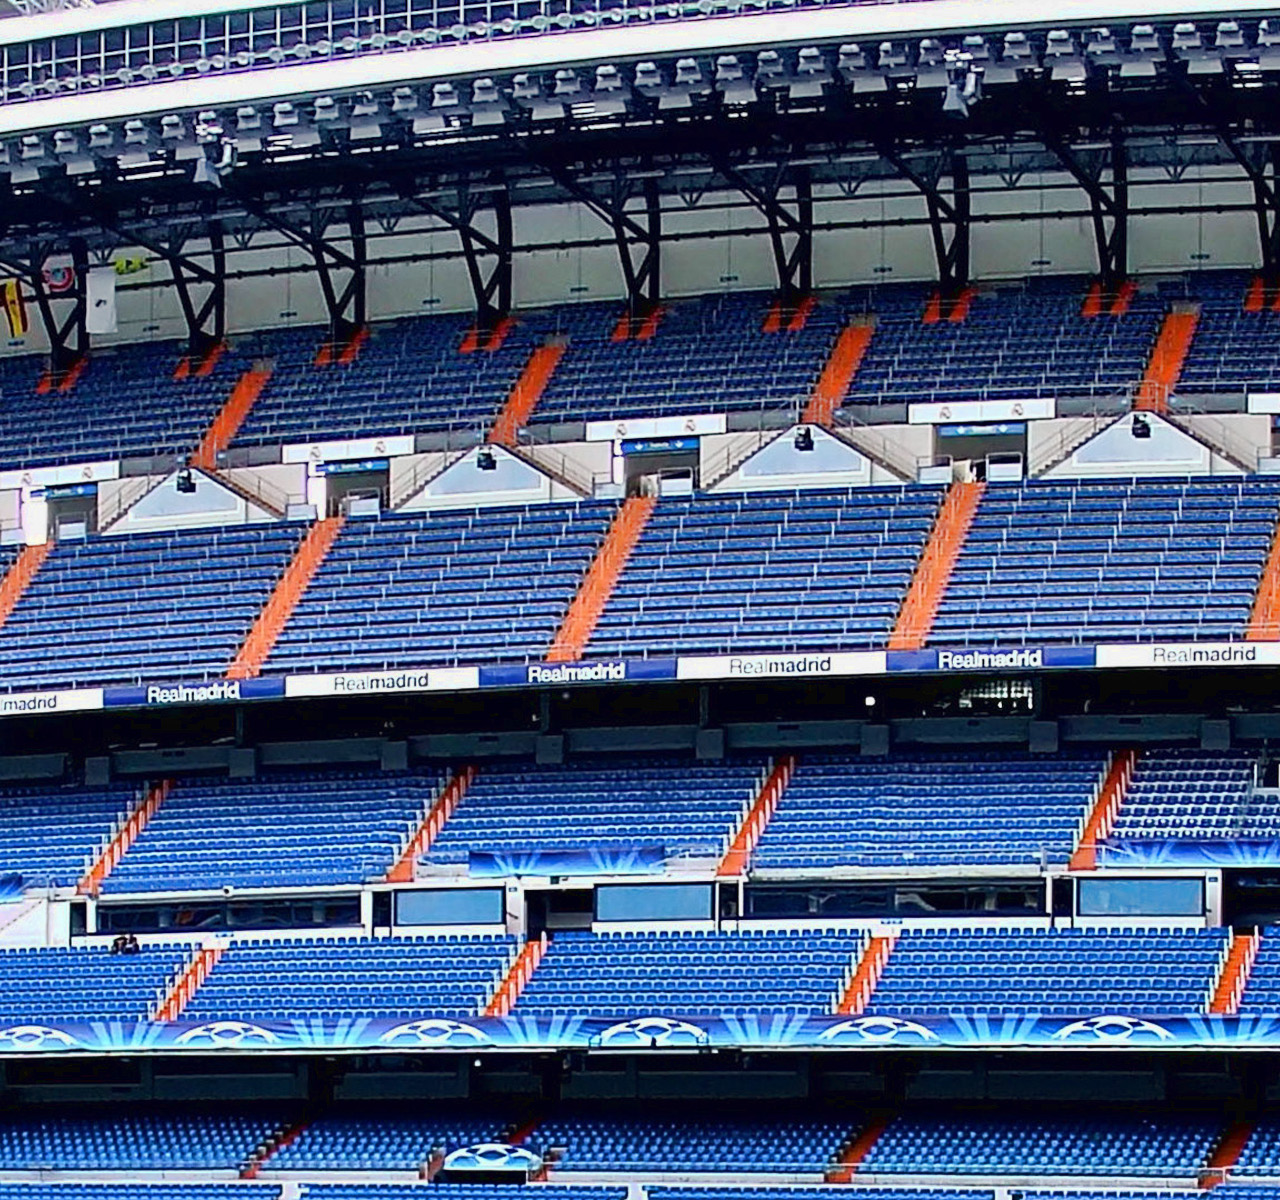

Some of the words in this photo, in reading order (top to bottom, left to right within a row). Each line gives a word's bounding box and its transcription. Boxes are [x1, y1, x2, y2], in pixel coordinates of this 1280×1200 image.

[939, 649, 1041, 669] Realmadrid
[1153, 644, 1255, 664] Realmadrid
[528, 663, 625, 682] Realmadrid
[729, 655, 831, 676] Realmadrid
[334, 671, 428, 692] Realmadrid
[148, 682, 239, 704] Realmadrid
